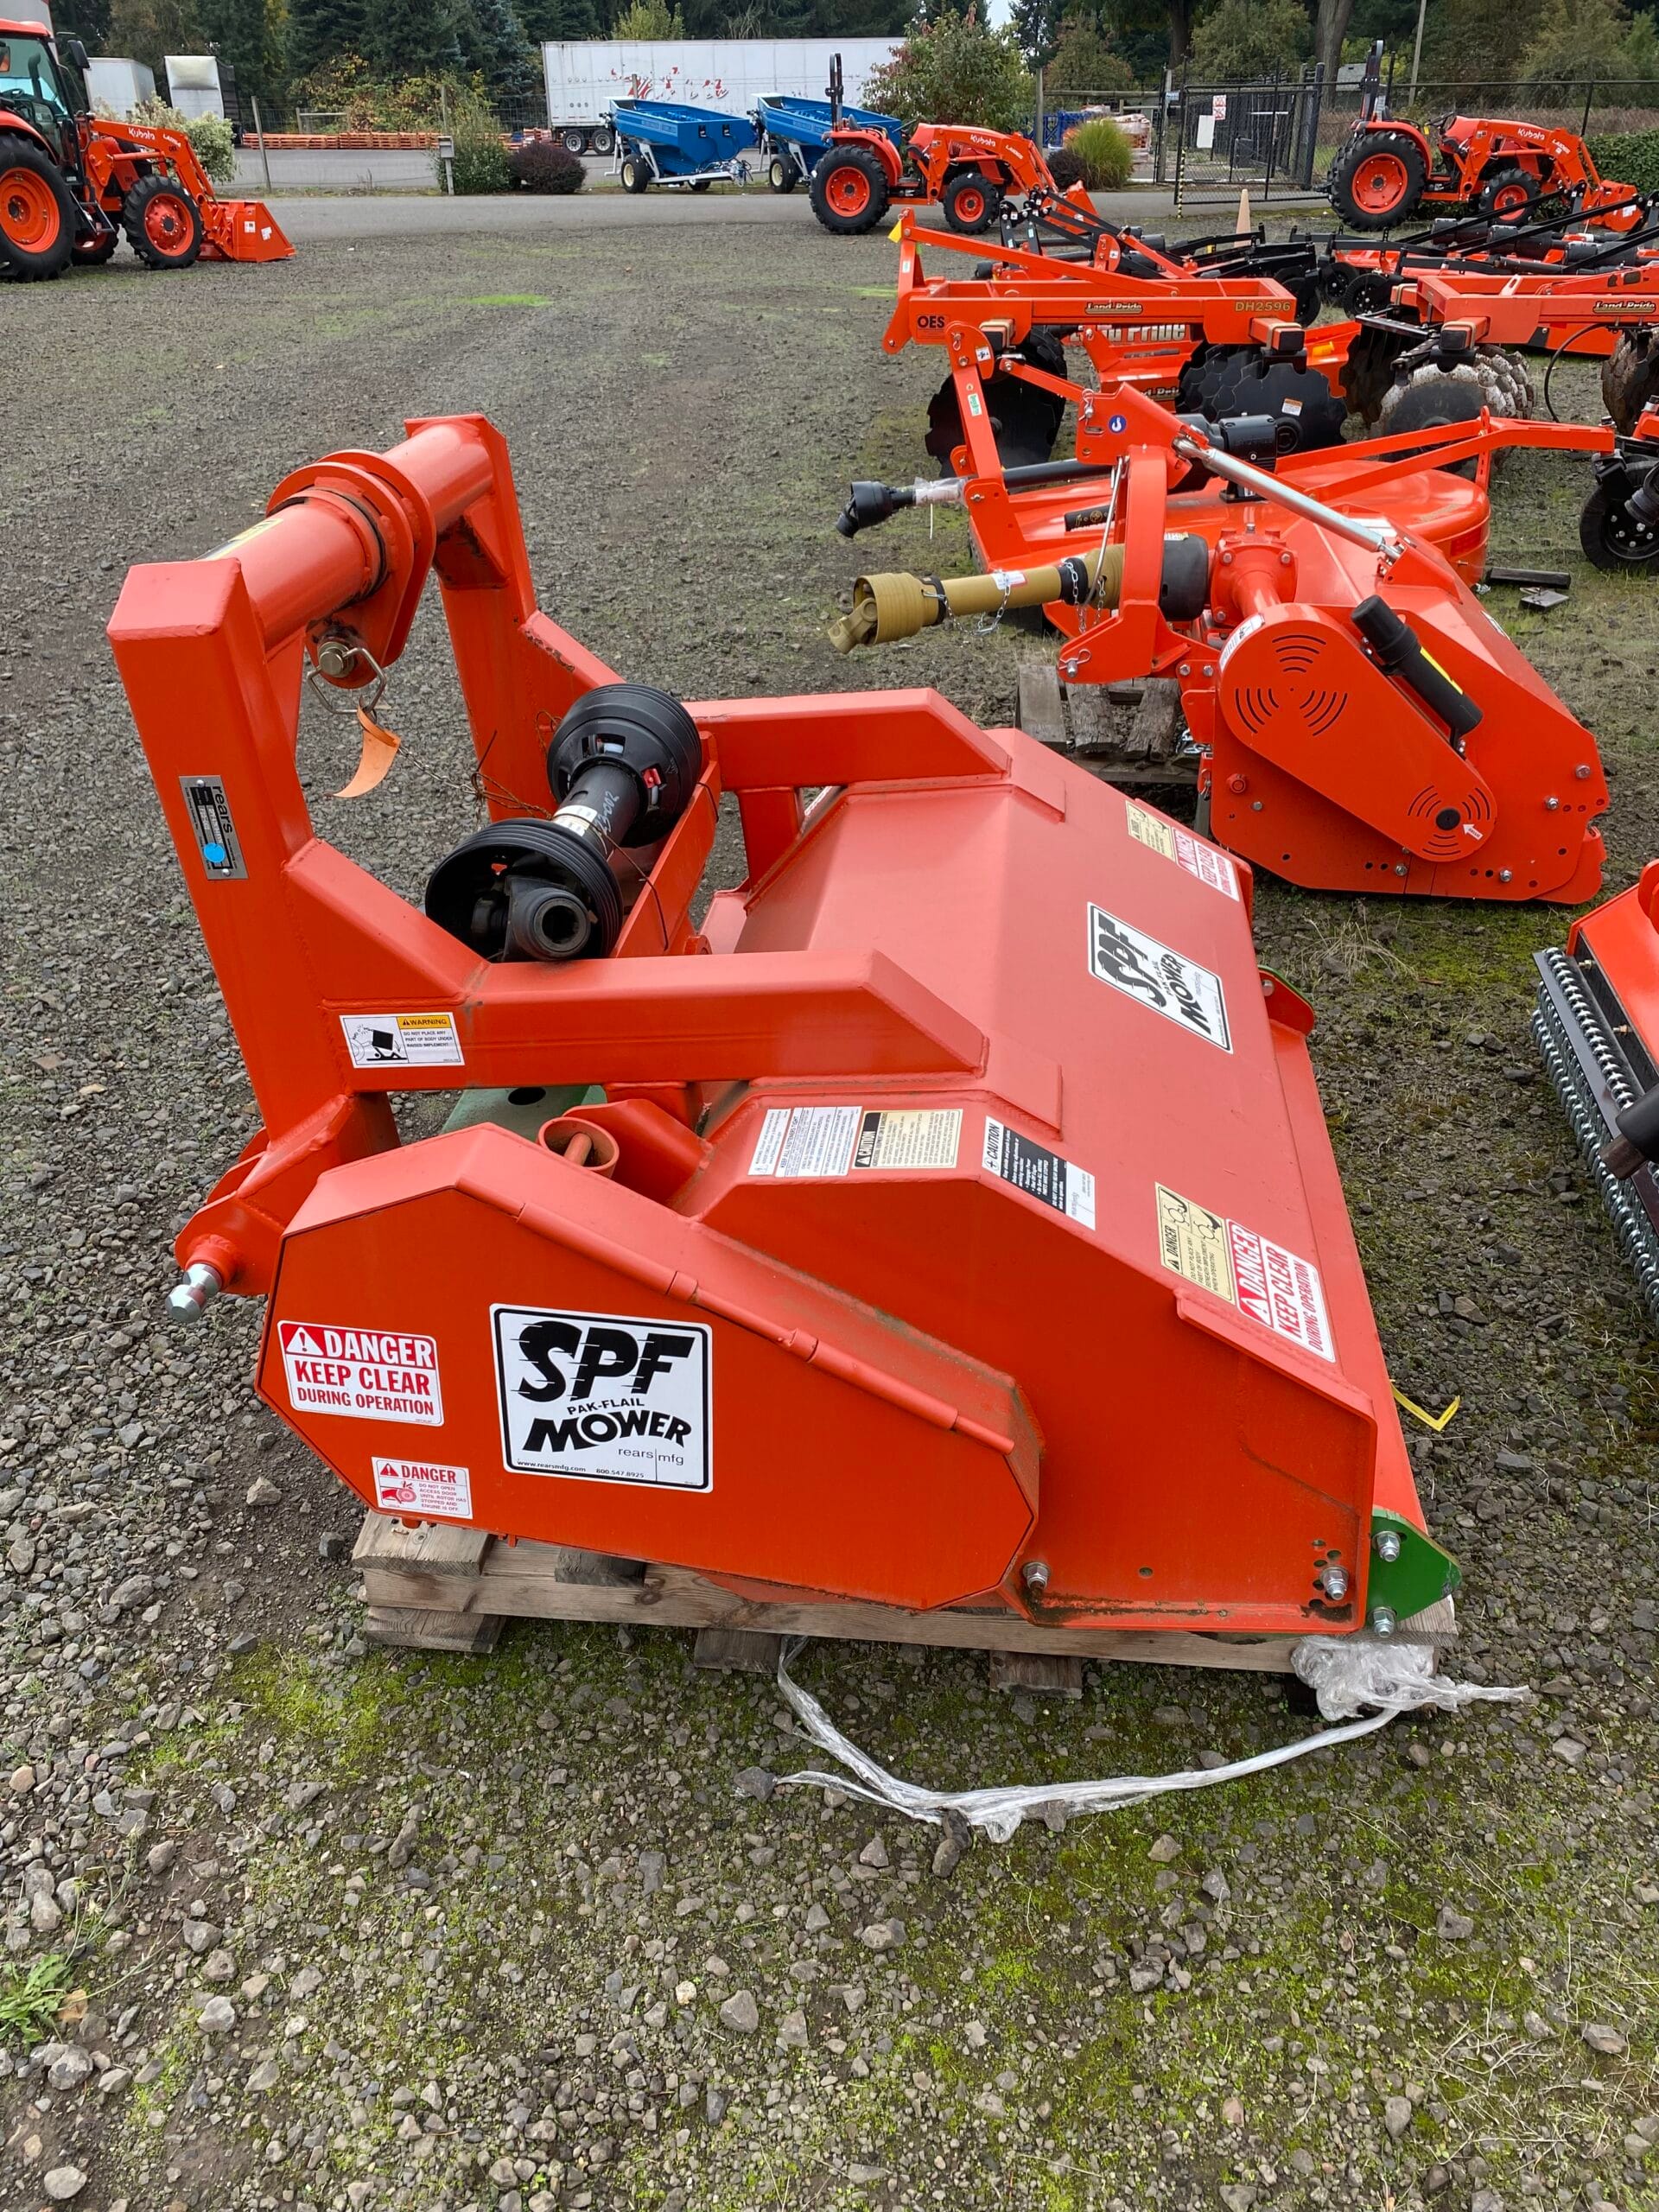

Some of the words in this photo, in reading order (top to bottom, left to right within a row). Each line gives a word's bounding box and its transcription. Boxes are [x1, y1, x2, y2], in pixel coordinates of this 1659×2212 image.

[128, 127, 155, 140] Kubota
[970, 134, 995, 147] Kubota
[1518, 128, 1545, 140] Kubota
[918, 315, 944, 328] OES
[1235, 302, 1291, 311] DH2596
[213, 786, 232, 834] rears
[1097, 912, 1167, 1007] SPF
[1160, 953, 1211, 1035] MOWER
[785, 1127, 796, 1148] FASTENERS
[858, 1130, 876, 1157] CAUTION
[987, 1122, 1000, 1160] CAUTION
[1164, 1224, 1178, 1257] DANGER
[1190, 1270, 1196, 1280] DO
[1231, 1224, 1267, 1295] DANGER
[1266, 1246, 1294, 1297] CLEAR
[1294, 1260, 1317, 1313] OPERATION
[1274, 1294, 1302, 1340] KEEP
[1304, 1312, 1324, 1352] DURING
[323, 1330, 434, 1368] DANGER
[518, 1320, 696, 1402] SPF
[295, 1360, 351, 1387] KEEP
[359, 1367, 431, 1396] CLEAR
[297, 1387, 351, 1407] DURING
[355, 1394, 434, 1416] OPERATION
[567, 1397, 645, 1415] PAK-FLAIL
[522, 1409, 692, 1452] MOWER
[517, 1459, 587, 1472] www.rearsmfg.com
[596, 1467, 645, 1478] 800.547.8925
[618, 1447, 653, 1459] rears
[658, 1452, 684, 1465] mfg
[401, 1465, 456, 1484] DANGER
